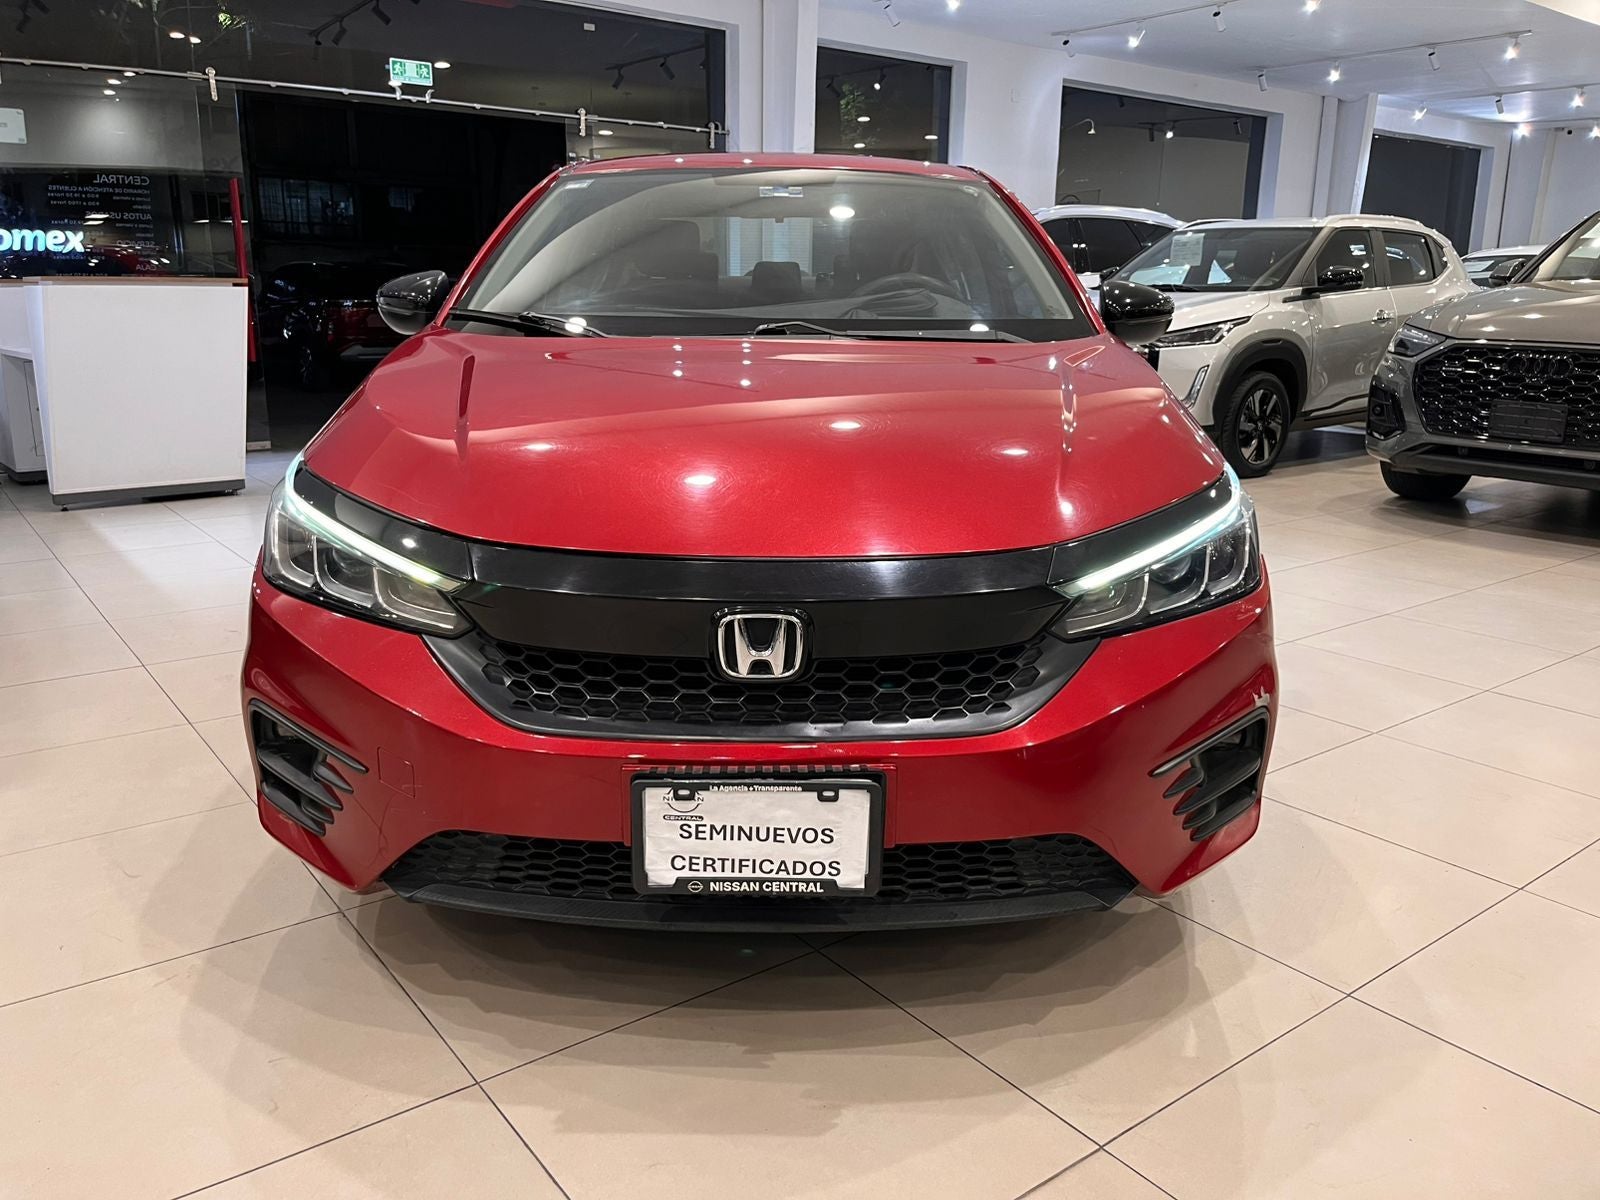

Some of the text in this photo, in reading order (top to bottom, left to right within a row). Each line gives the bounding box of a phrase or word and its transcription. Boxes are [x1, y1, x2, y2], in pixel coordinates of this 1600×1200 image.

[720, 785, 748, 793] Agencia
[679, 823, 835, 844] SEMINUEVOS
[670, 854, 842, 877] CERTIFICADOS
[710, 881, 824, 893] NISSAN CENTRAL
